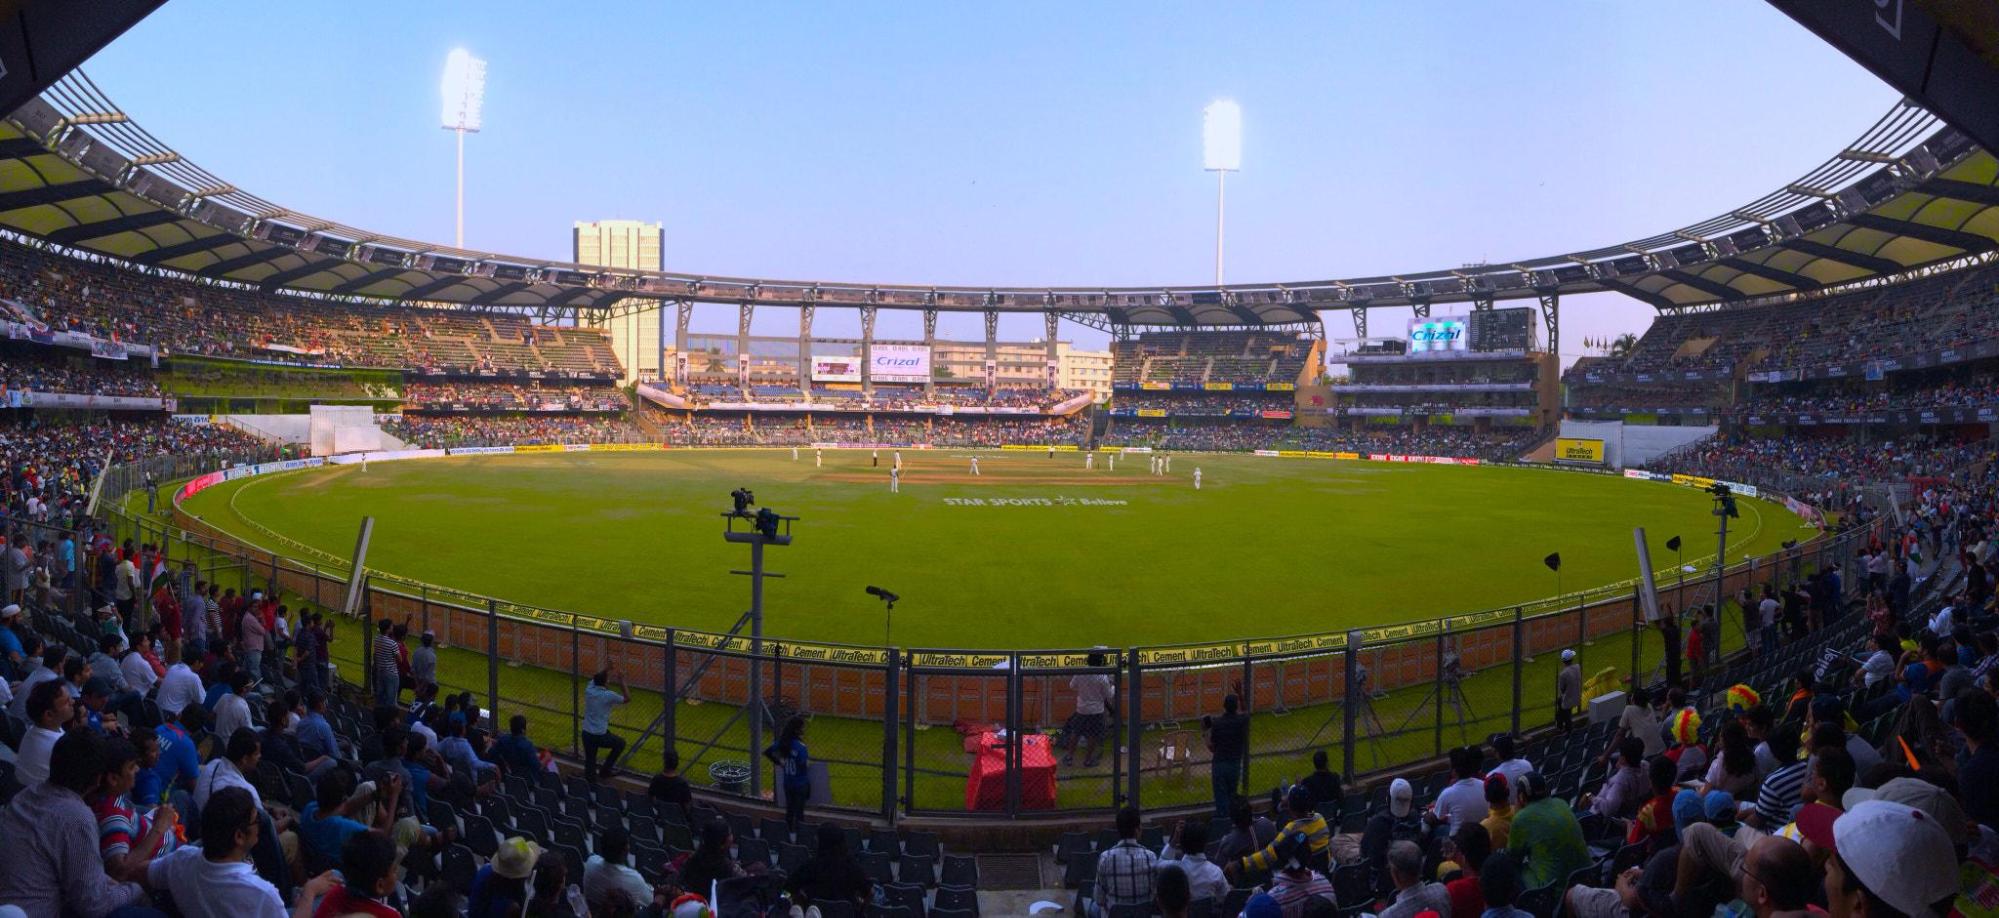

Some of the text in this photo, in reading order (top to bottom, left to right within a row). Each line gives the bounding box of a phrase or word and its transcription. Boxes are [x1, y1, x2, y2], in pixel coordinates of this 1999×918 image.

[1412, 329, 1461, 341] Crizal
[877, 356, 920, 366] Crizal
[943, 497, 1128, 506] STAR SPORTS Believe
[794, 646, 825, 658] Cement
[832, 648, 874, 662] UltraTech
[922, 654, 965, 666] UltraTech
[1154, 650, 1186, 661] Cement
[1193, 648, 1231, 660] UltraTech
[1278, 638, 1312, 652] UltraTech
[1317, 635, 1344, 647] Cement
